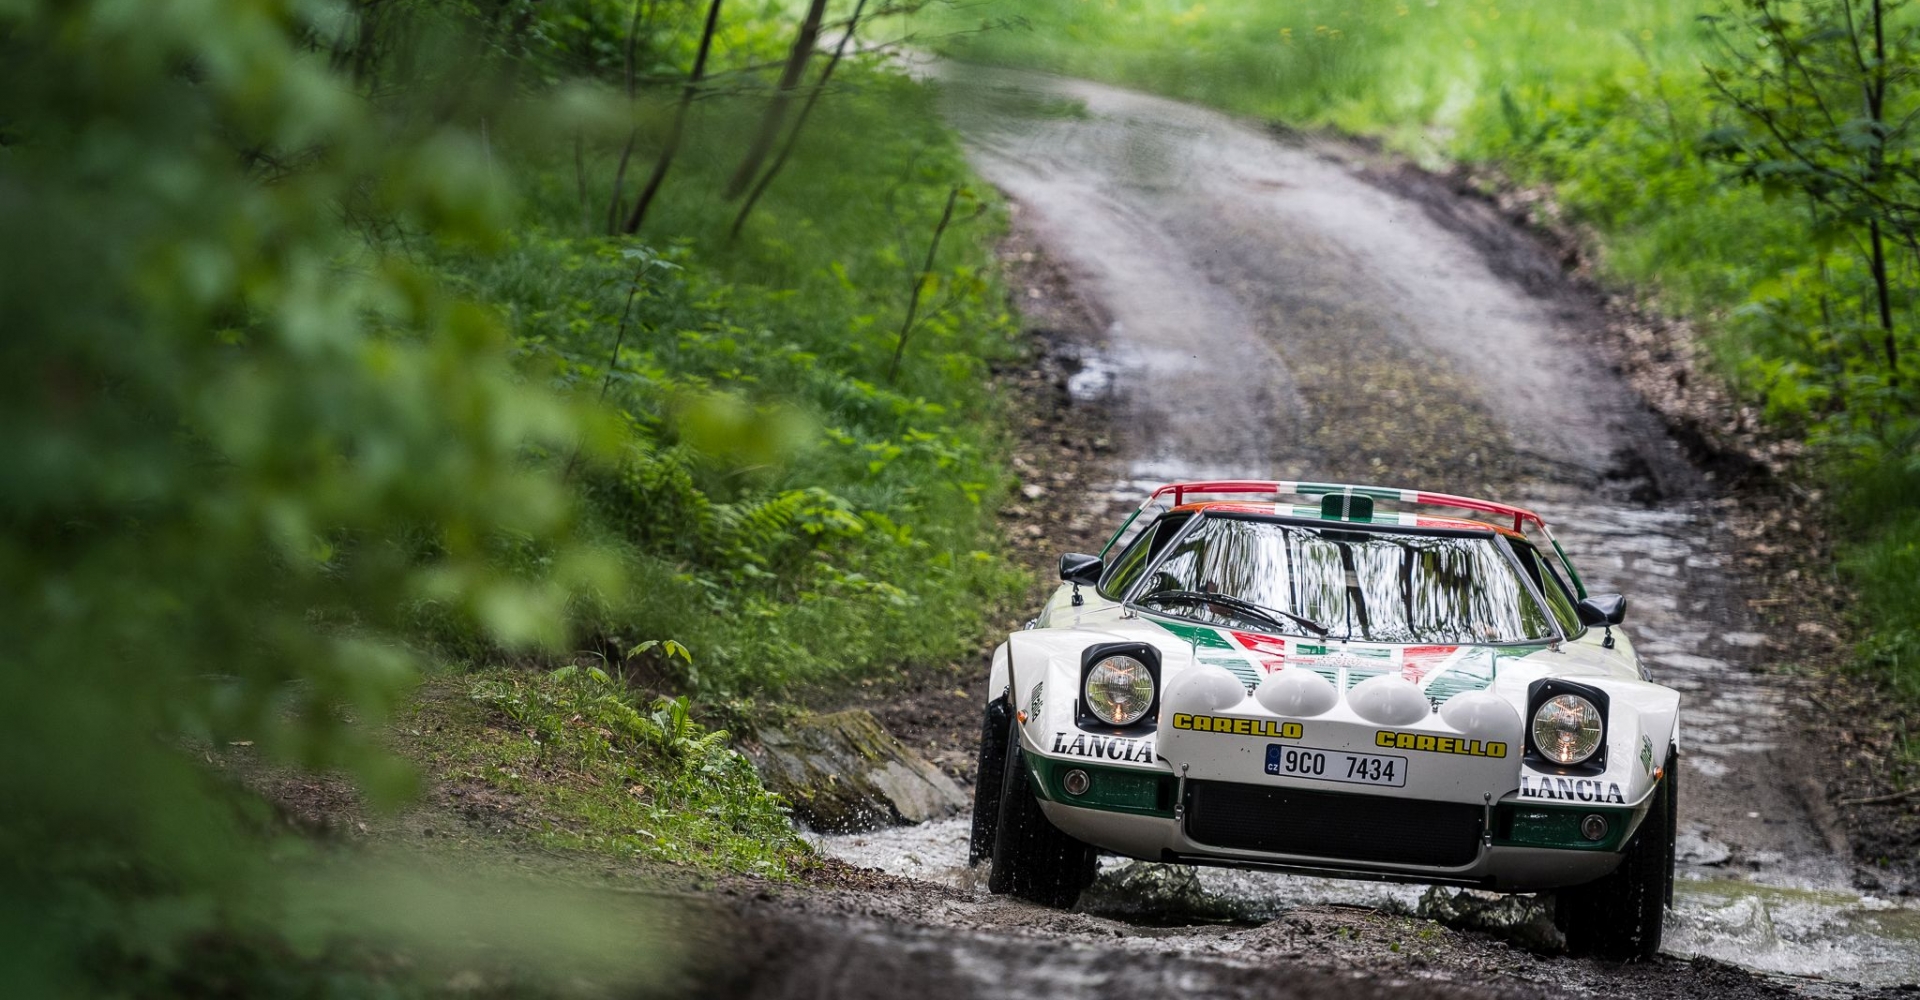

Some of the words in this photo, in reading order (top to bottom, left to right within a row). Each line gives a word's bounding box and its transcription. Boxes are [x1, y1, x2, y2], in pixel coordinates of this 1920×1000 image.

[1173, 713, 1303, 739] CARELLO
[1051, 732, 1153, 764] LANCIA
[1376, 730, 1507, 758] CARELLO
[1267, 763, 1279, 771] CZ
[1346, 756, 1395, 782] 7434
[1521, 776, 1626, 804] LANCIA
